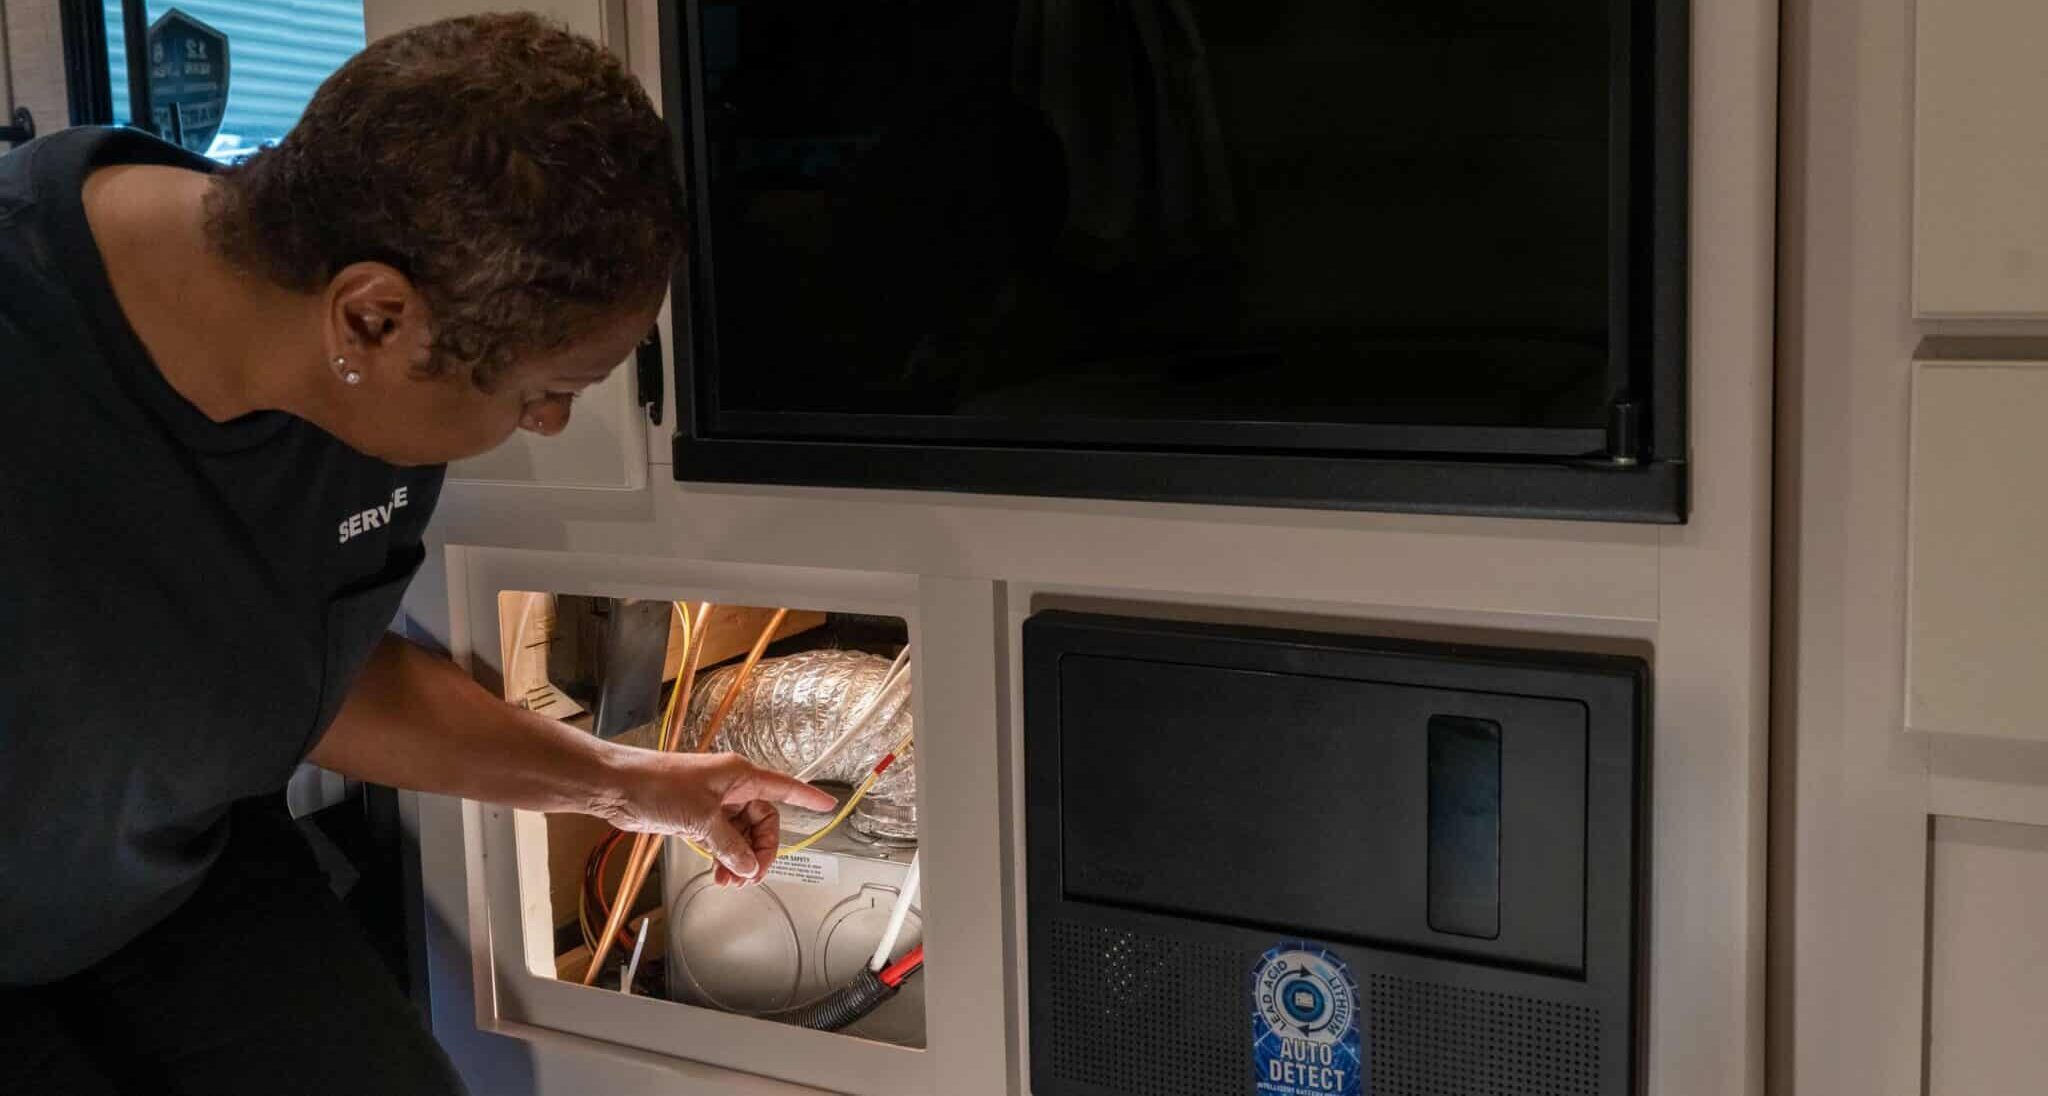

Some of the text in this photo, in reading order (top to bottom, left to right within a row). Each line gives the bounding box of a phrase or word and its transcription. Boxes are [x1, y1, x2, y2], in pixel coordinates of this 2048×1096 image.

[338, 486, 409, 544] SERVE
[1262, 960, 1288, 1031] LEAD ACID
[1327, 976, 1347, 1035] LITHIUM
[1269, 1059, 1345, 1092] DETECT
[1280, 1037, 1332, 1066] AUTO
